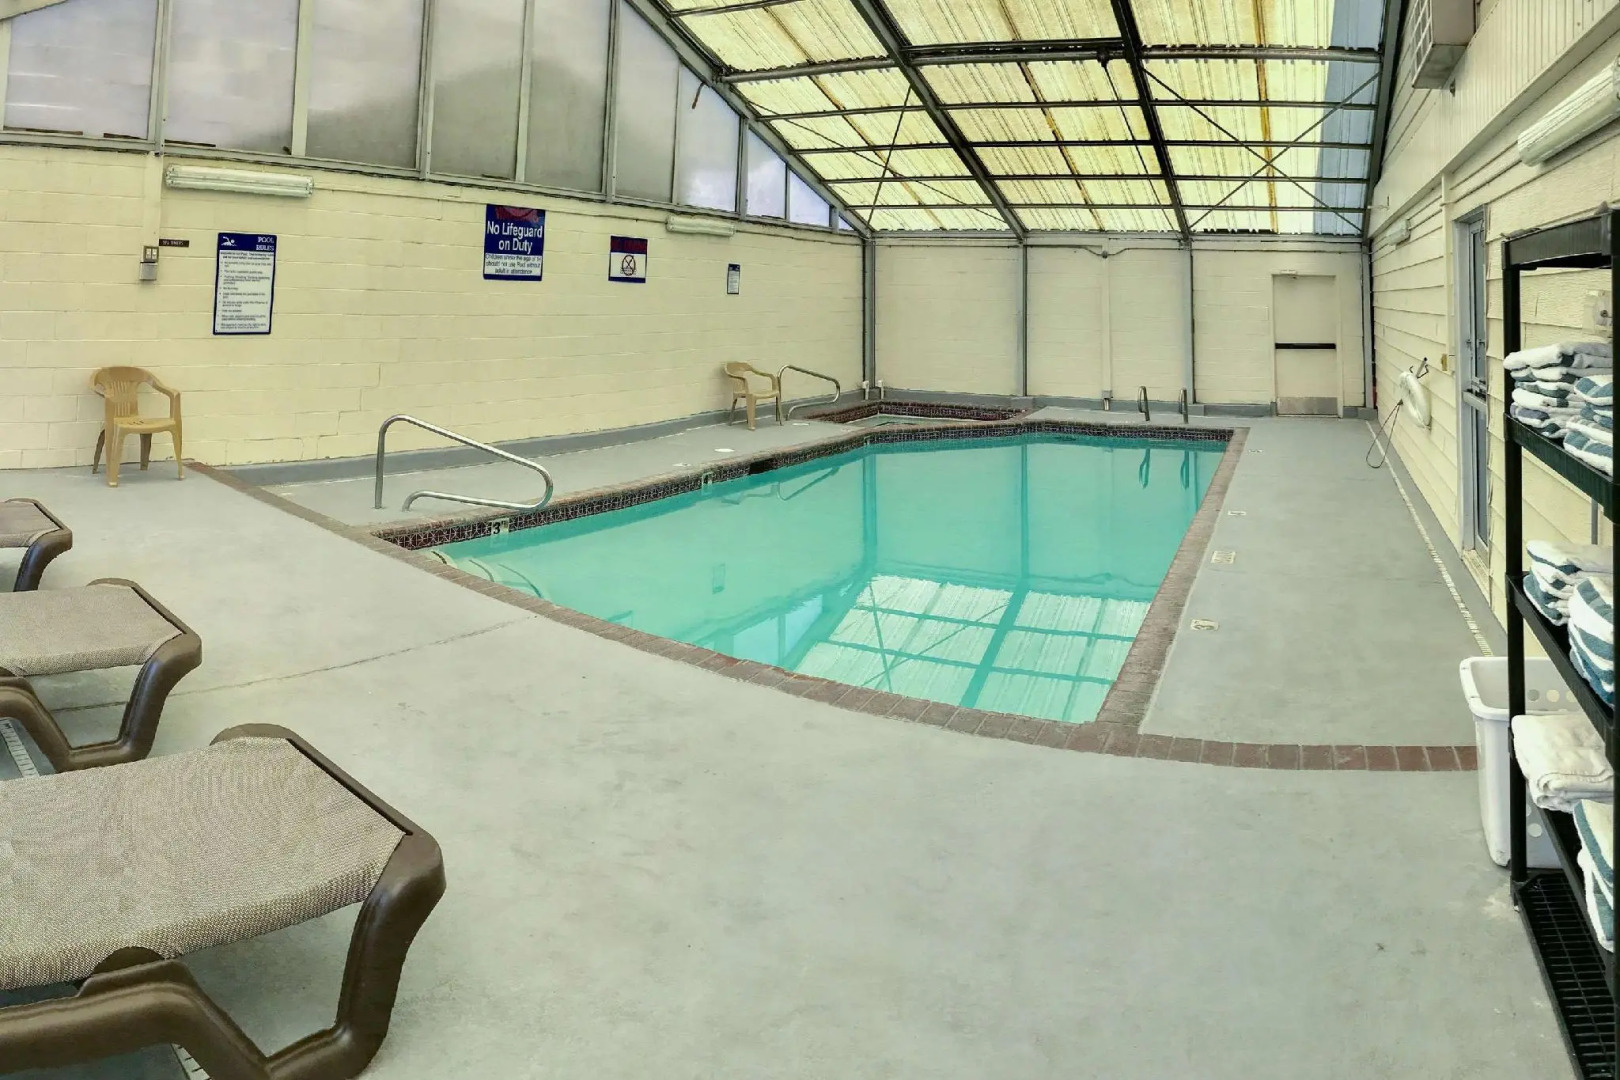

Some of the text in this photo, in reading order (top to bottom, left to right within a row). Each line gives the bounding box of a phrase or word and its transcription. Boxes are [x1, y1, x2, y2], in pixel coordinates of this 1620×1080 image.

[487, 221, 543, 239] No Lifeguard
[498, 238, 533, 255] on Duty
